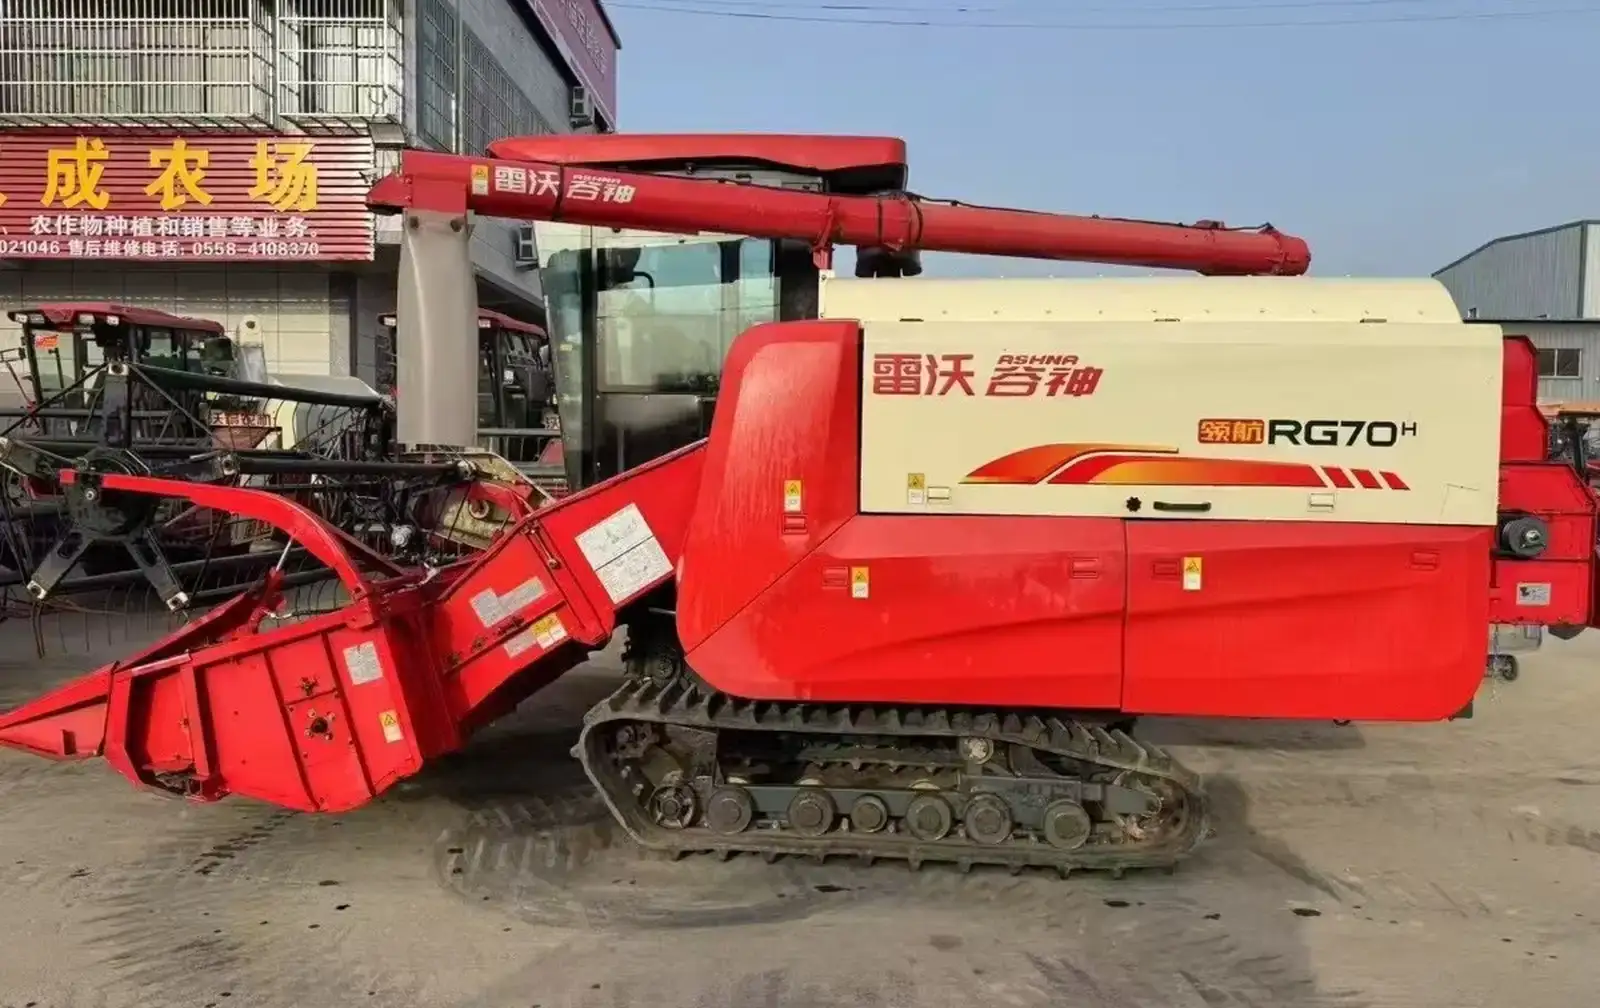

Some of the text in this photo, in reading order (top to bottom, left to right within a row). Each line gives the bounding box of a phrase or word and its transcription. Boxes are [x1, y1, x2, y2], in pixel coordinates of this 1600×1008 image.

[0, 136, 318, 212] 成农场
[495, 165, 560, 197] 雷沃
[873, 353, 1104, 397] 雷沃 谷神
[997, 354, 1079, 365] ASHNA
[1200, 420, 1264, 442] 领航
